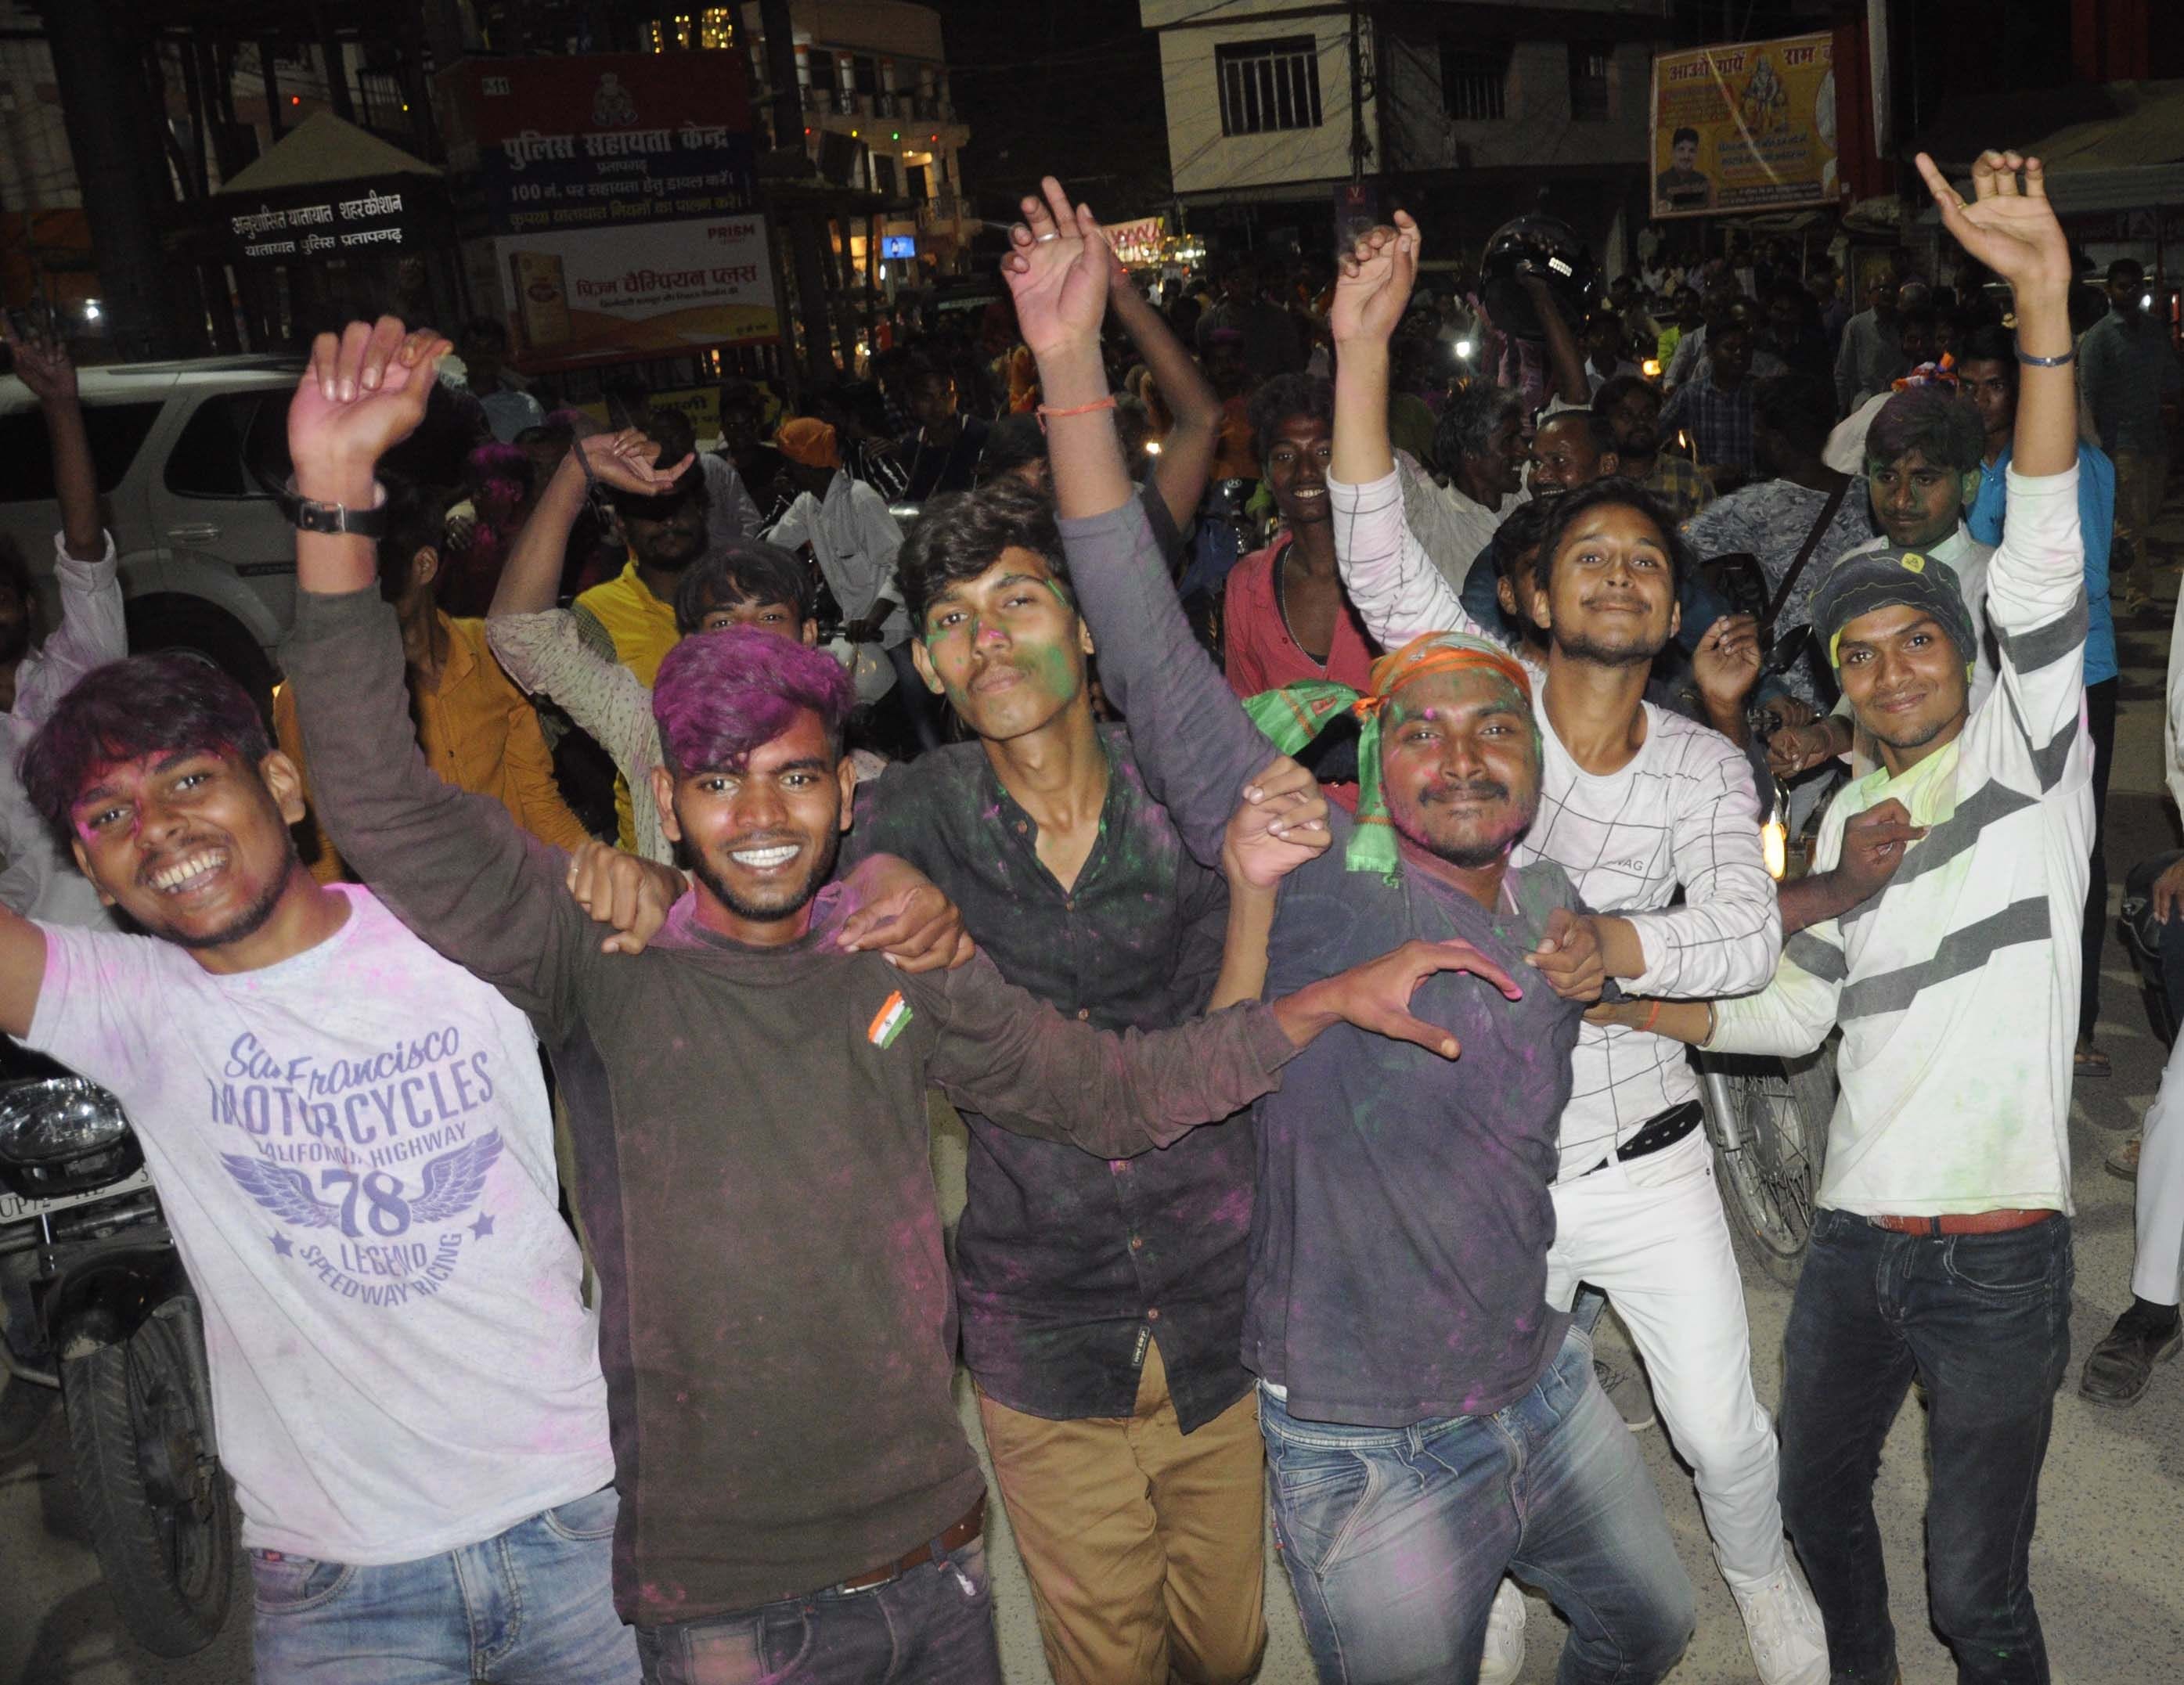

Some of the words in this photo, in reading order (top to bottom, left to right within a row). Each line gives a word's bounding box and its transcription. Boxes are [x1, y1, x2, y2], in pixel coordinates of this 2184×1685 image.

[1783, 46, 1816, 65] राम
[501, 128, 575, 171] पुलिस
[582, 128, 672, 157] सहायता
[677, 119, 729, 150] केन्द्र
[511, 182, 541, 201] 100
[565, 183, 586, 198] पर
[587, 180, 639, 197] सहायता
[642, 175, 665, 197] हेतु
[665, 175, 703, 190] डायल
[231, 203, 286, 239] अनुशासित
[287, 204, 333, 227] यातायात
[509, 211, 550, 232] कृपया
[552, 207, 607, 223] यातायात
[245, 241, 296, 257] यातायात
[300, 234, 337, 255] पुलिस
[340, 228, 403, 247] प्रतापगढ़
[625, 269, 705, 293] चैम्पियन
[711, 264, 758, 285] प्लस
[369, 1121, 466, 1168] HIGHWAY
[322, 1168, 412, 1238] 78
[300, 1245, 408, 1307] SPEEDWAY
[412, 1233, 462, 1296] RACING
[341, 1243, 427, 1277] LEGEND
